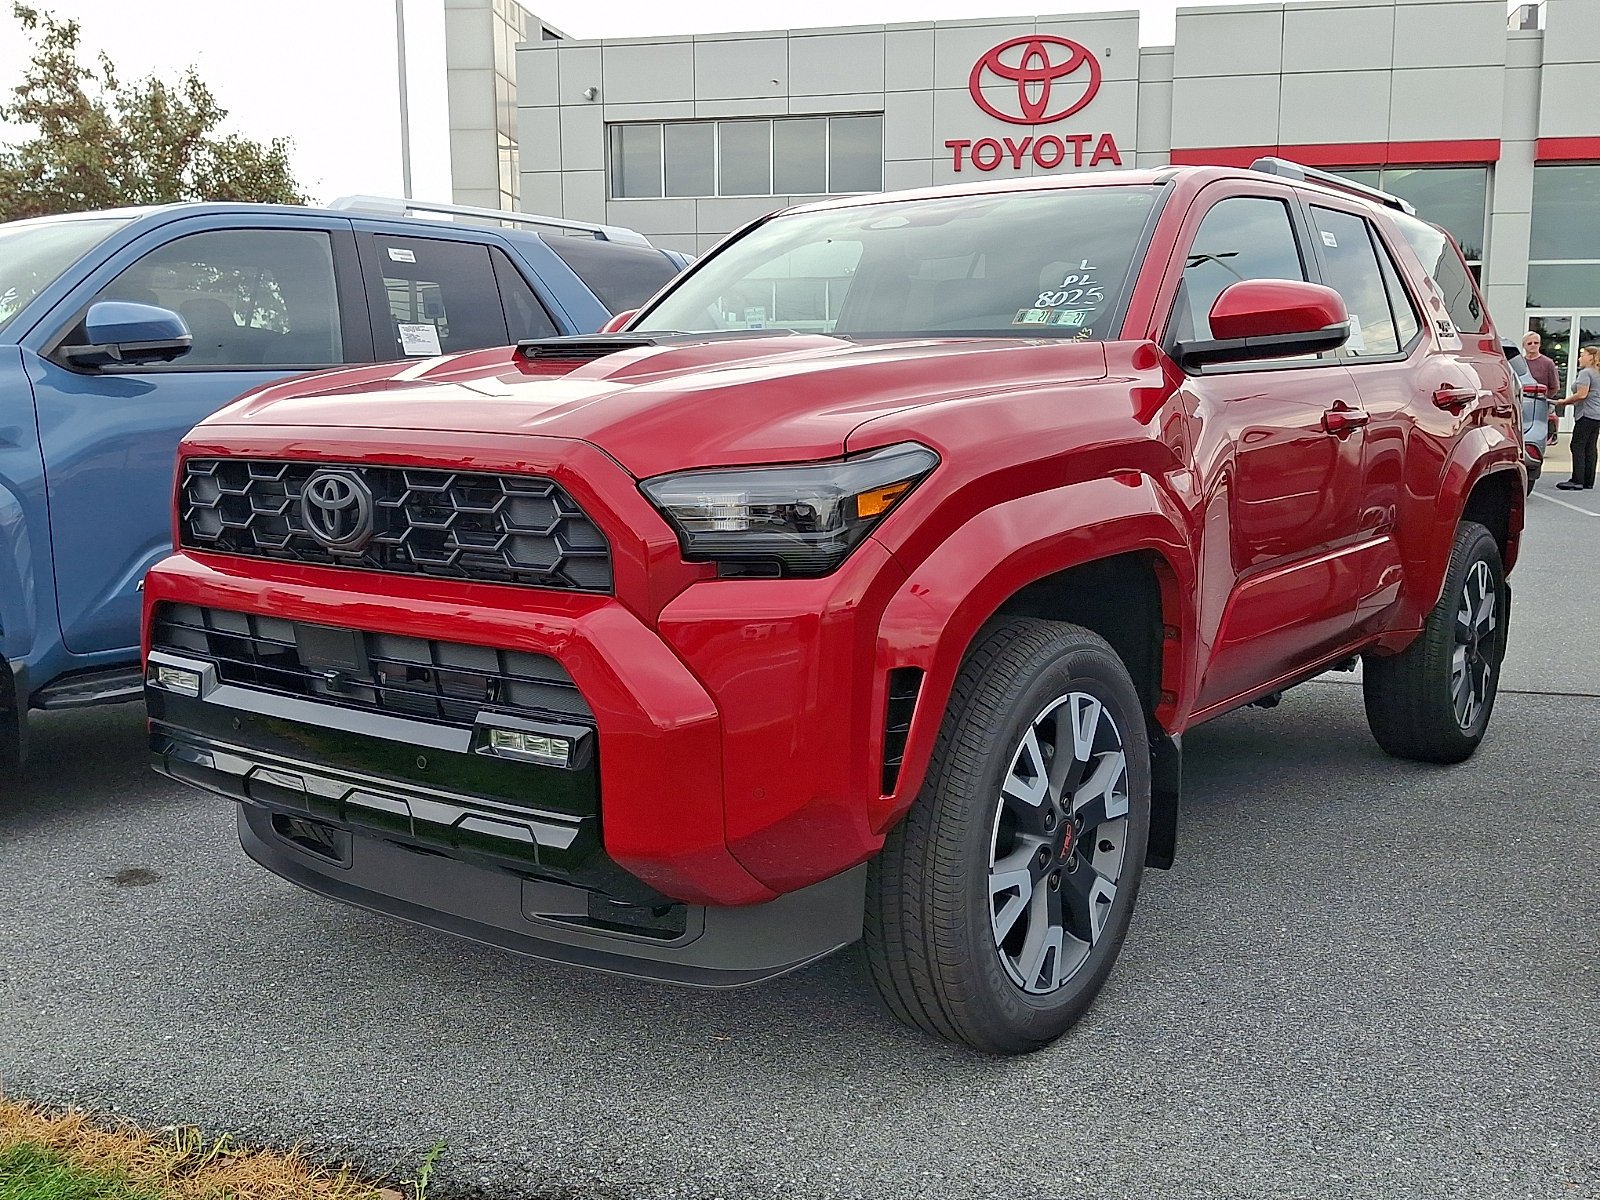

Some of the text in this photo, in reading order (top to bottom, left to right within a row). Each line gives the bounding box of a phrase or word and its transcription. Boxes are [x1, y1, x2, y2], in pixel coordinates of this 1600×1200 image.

[944, 133, 1122, 172] TOYOTA
[1080, 259, 1097, 270] L
[1034, 286, 1105, 308] 8025
[1037, 310, 1050, 323] 27
[1072, 312, 1085, 324] 27
[1059, 823, 1072, 859] TRD
